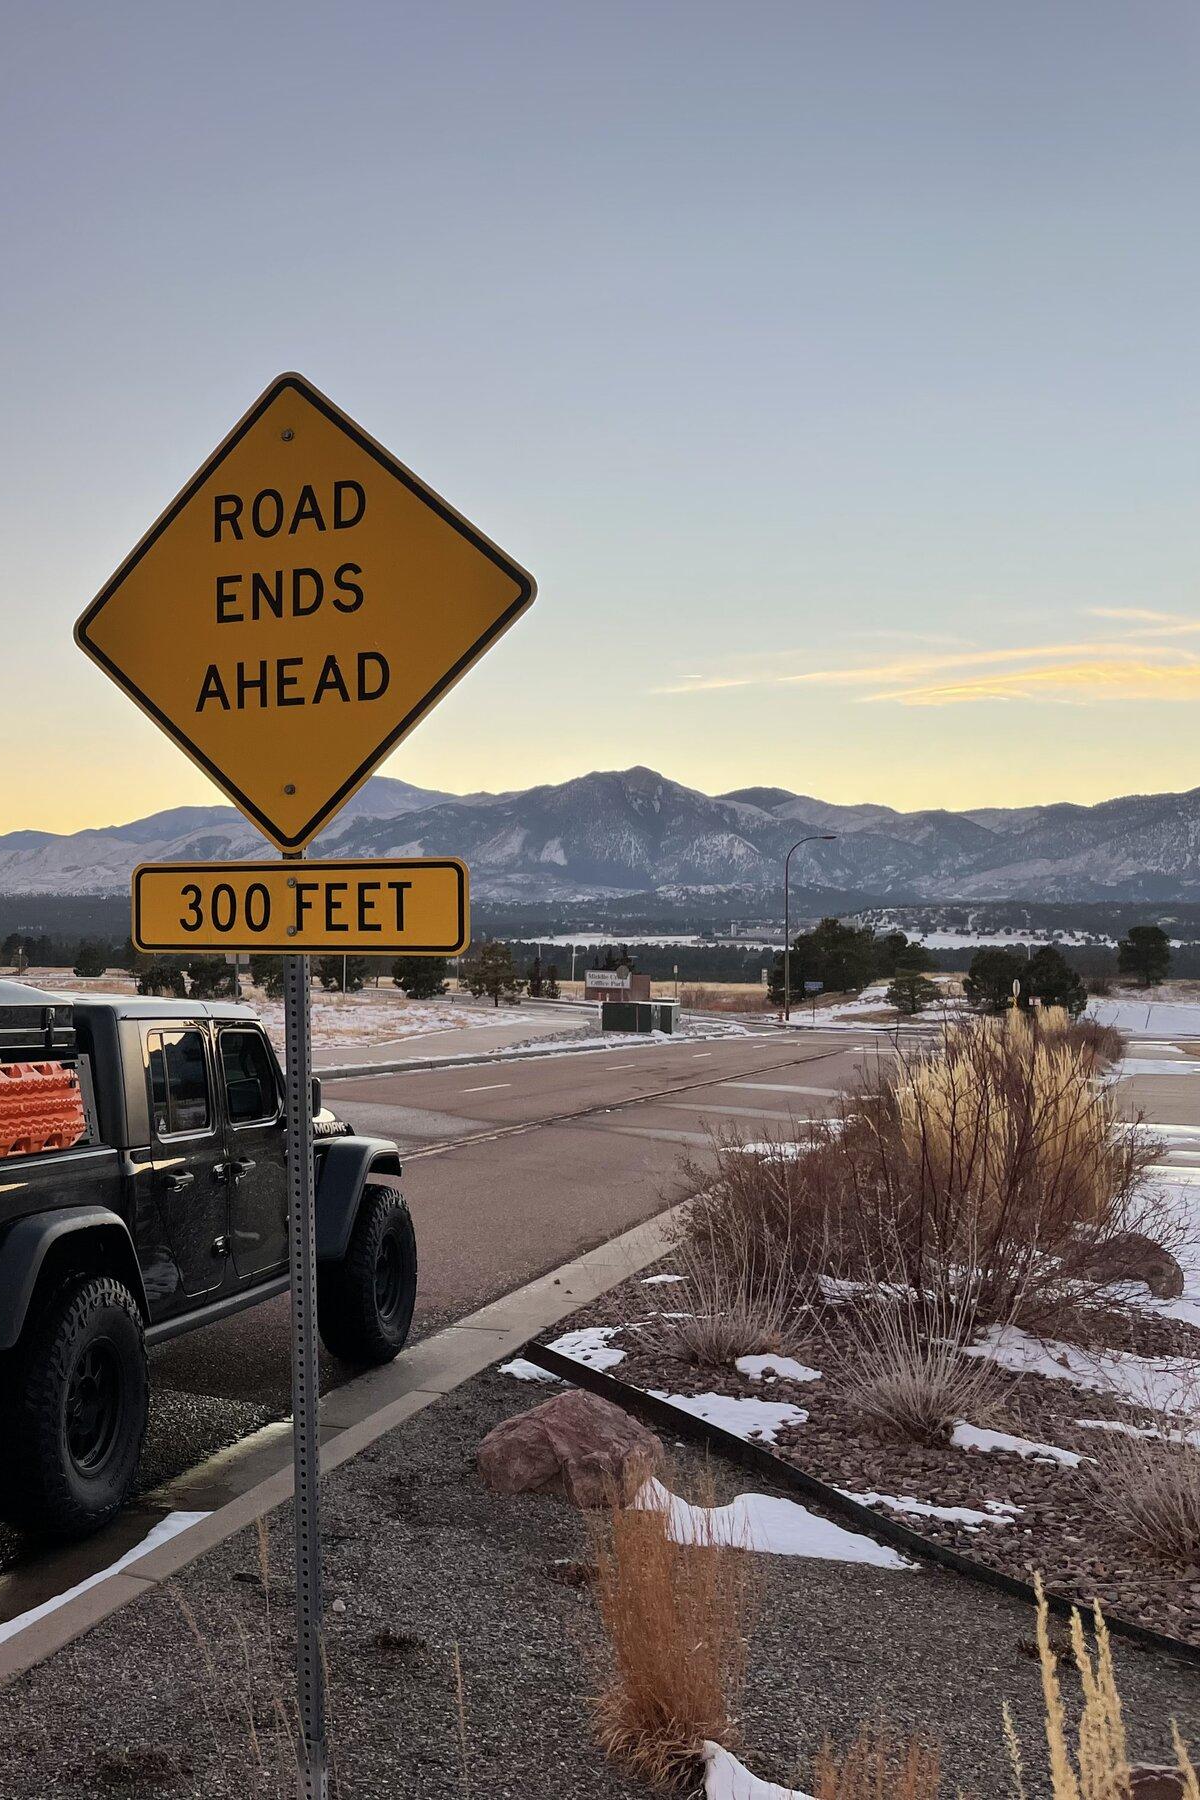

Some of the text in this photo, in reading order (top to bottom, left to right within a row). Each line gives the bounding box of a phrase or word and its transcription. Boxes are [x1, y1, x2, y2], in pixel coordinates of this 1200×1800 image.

[214, 480, 366, 543] ROAD
[216, 562, 364, 624] ENDS
[195, 651, 390, 712] AHEAD
[179, 881, 412, 932] 300 FEET
